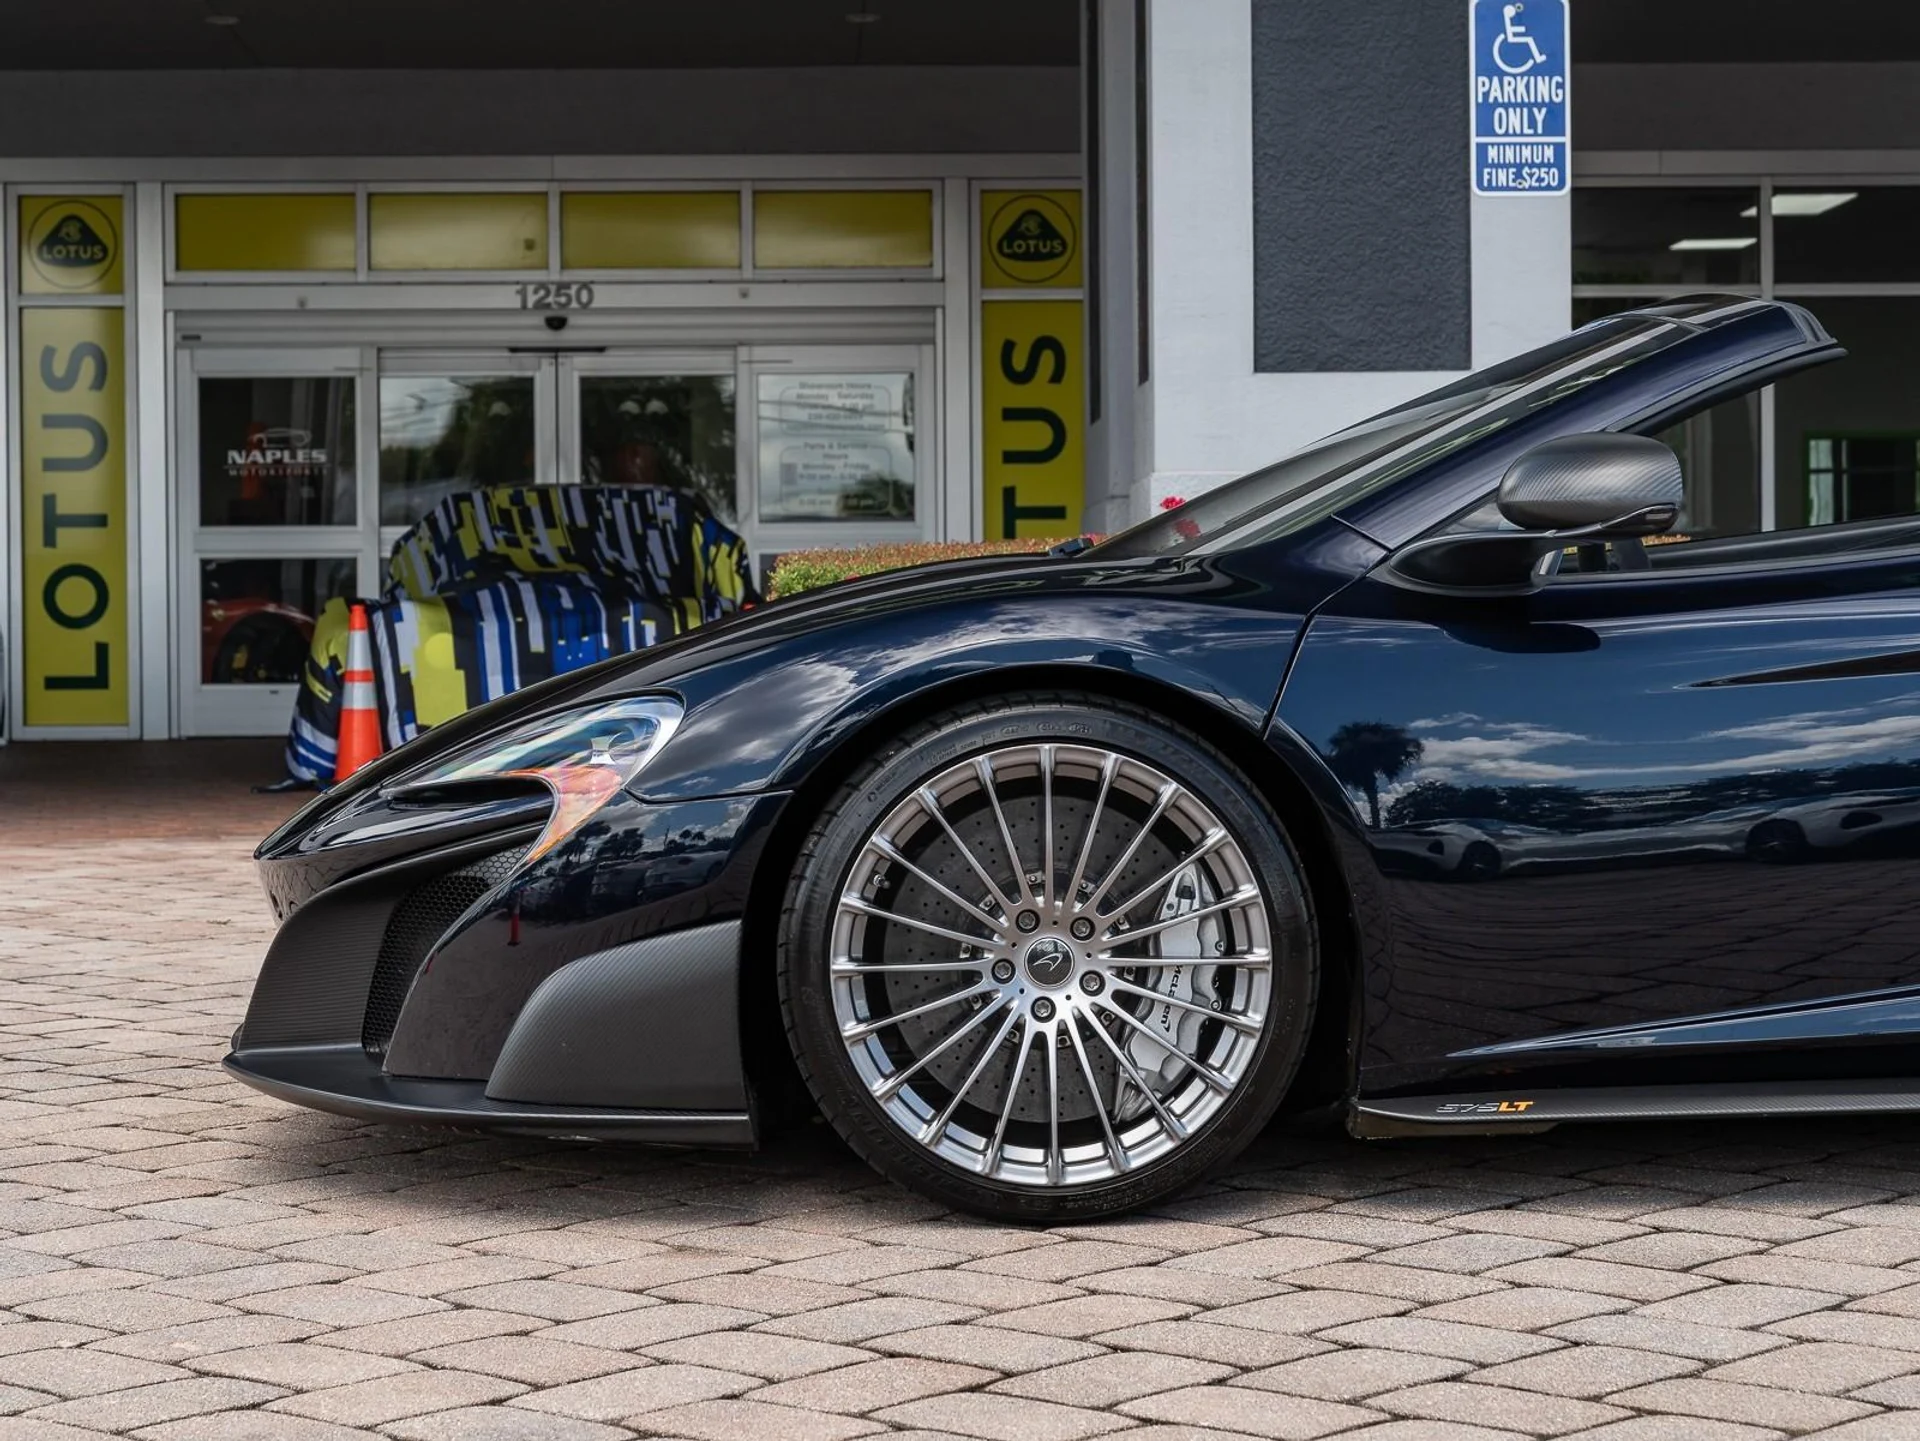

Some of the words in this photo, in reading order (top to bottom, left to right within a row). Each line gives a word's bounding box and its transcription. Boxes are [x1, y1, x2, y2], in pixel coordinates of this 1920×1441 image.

[1477, 76, 1564, 104] PARKING
[1493, 107, 1547, 135] ONLY
[1487, 144, 1555, 165] MINIMUM
[1483, 168, 1517, 187] FINE
[1521, 166, 1559, 189] $250
[41, 244, 104, 261] LOTUS
[1002, 239, 1064, 254] LOTUS
[515, 283, 595, 310] 1250
[1001, 335, 1067, 540] TUS
[227, 449, 328, 464] NAPLES
[40, 341, 110, 690] LOTUS
[1161, 965, 1183, 1025] McLaen
